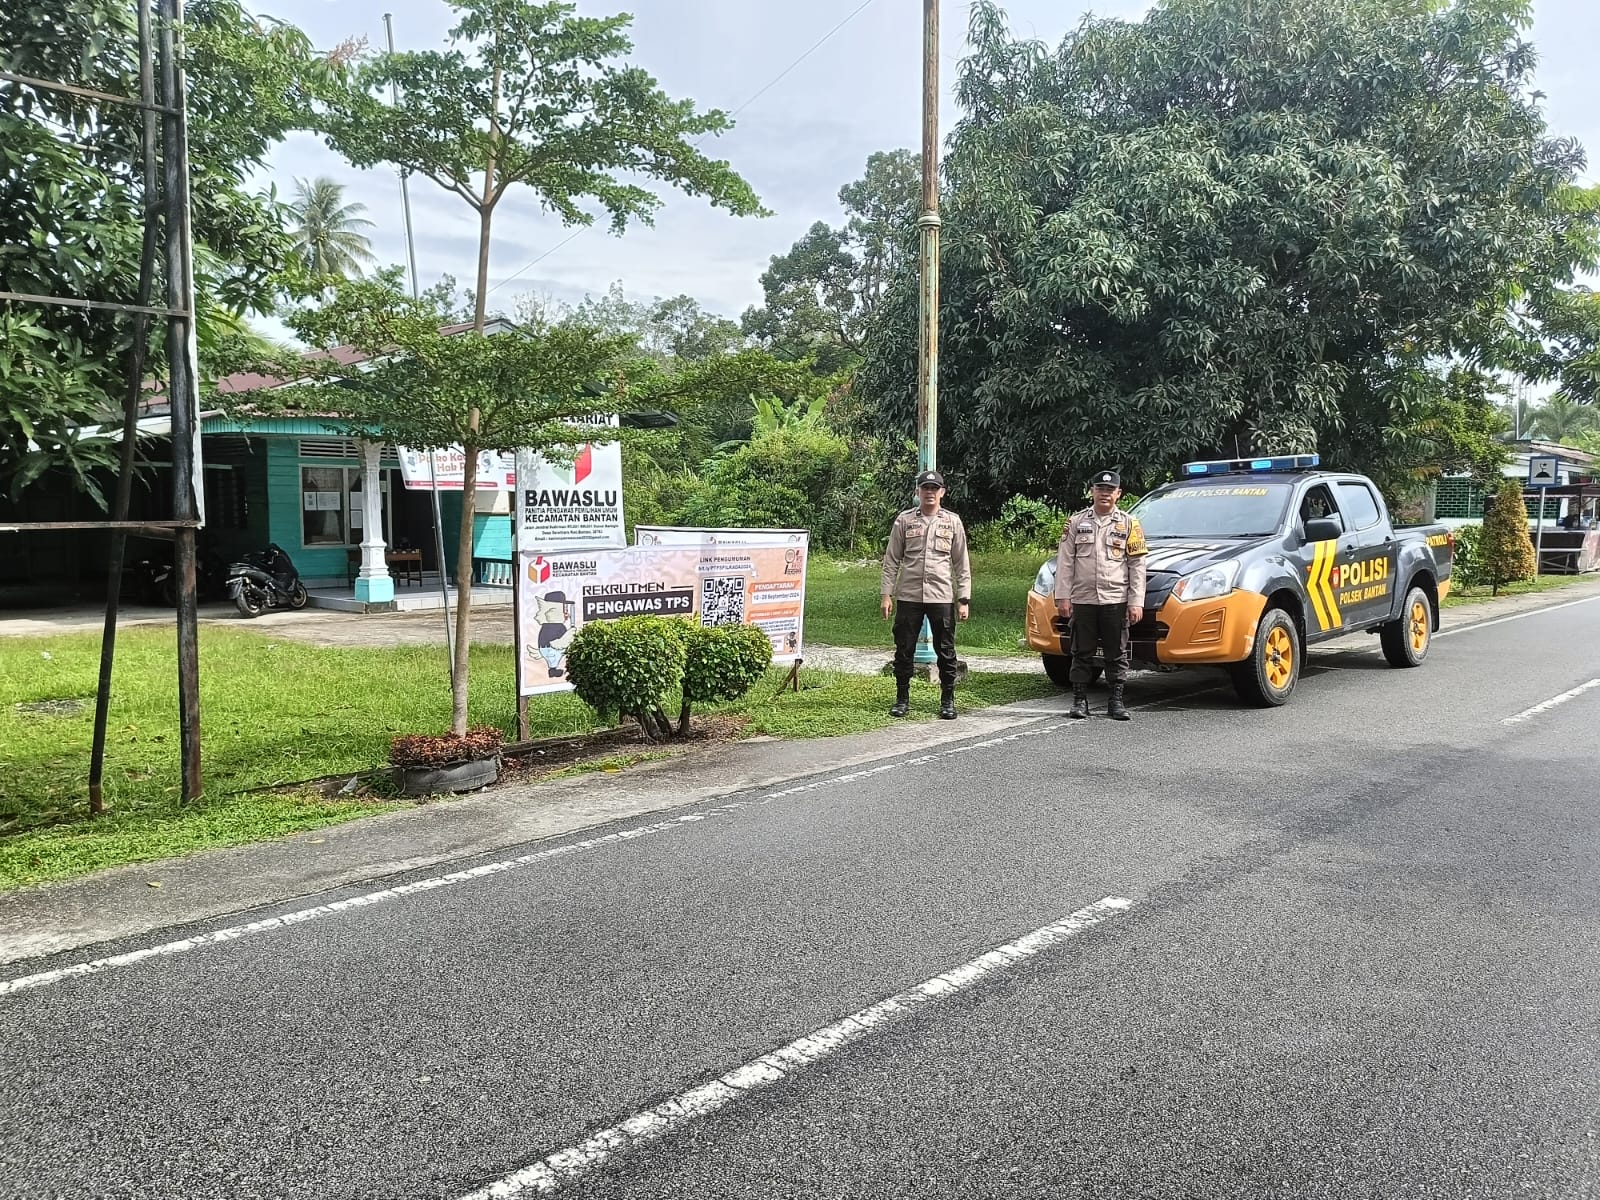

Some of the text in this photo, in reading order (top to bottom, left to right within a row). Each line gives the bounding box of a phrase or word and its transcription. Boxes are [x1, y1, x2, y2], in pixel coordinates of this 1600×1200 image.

[525, 489, 617, 507] BAWASLU
[1232, 488, 1267, 496] BANTAN
[525, 513, 618, 523] KECAMATAN BANTAN
[1425, 534, 1448, 546] PATROLI
[552, 561, 597, 570] BAWASLU
[1340, 557, 1388, 588] POLISI
[583, 582, 664, 596] REKRUTMEN
[1340, 583, 1387, 605] POLSEK BANTAN
[587, 596, 690, 615] PENGAWAS TPS
